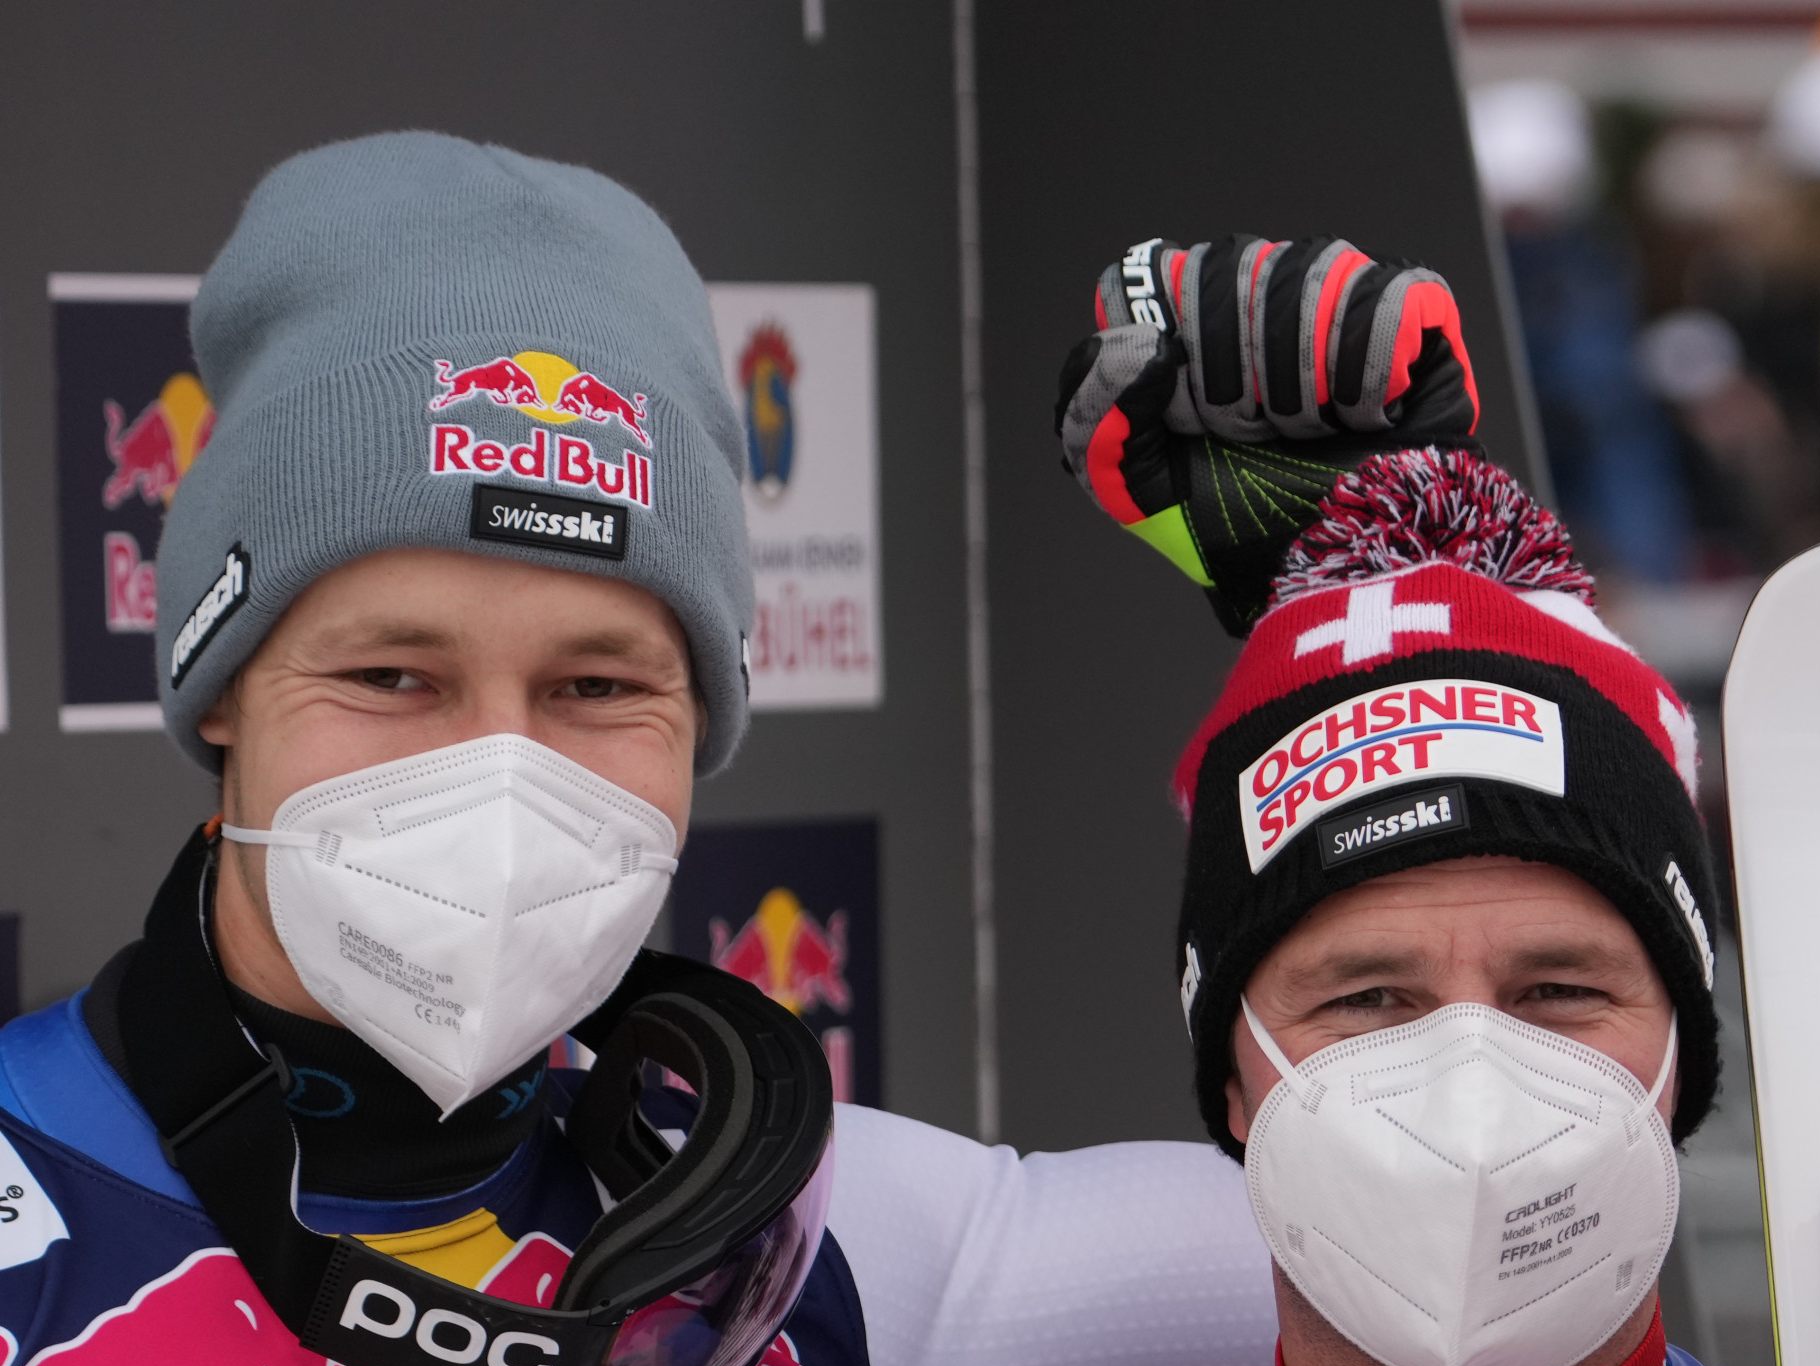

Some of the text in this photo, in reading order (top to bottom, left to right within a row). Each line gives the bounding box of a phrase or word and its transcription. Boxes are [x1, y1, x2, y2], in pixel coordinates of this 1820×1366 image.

[432, 425, 651, 507] Red Bull
[489, 502, 614, 545] swissski
[1252, 686, 1543, 798] OCHSNER
[1259, 733, 1443, 851] SPORT
[1334, 795, 1451, 854] swissski
[338, 921, 454, 985] CARE0086 FFP2 NR
[1502, 1222, 1537, 1242] Model:
